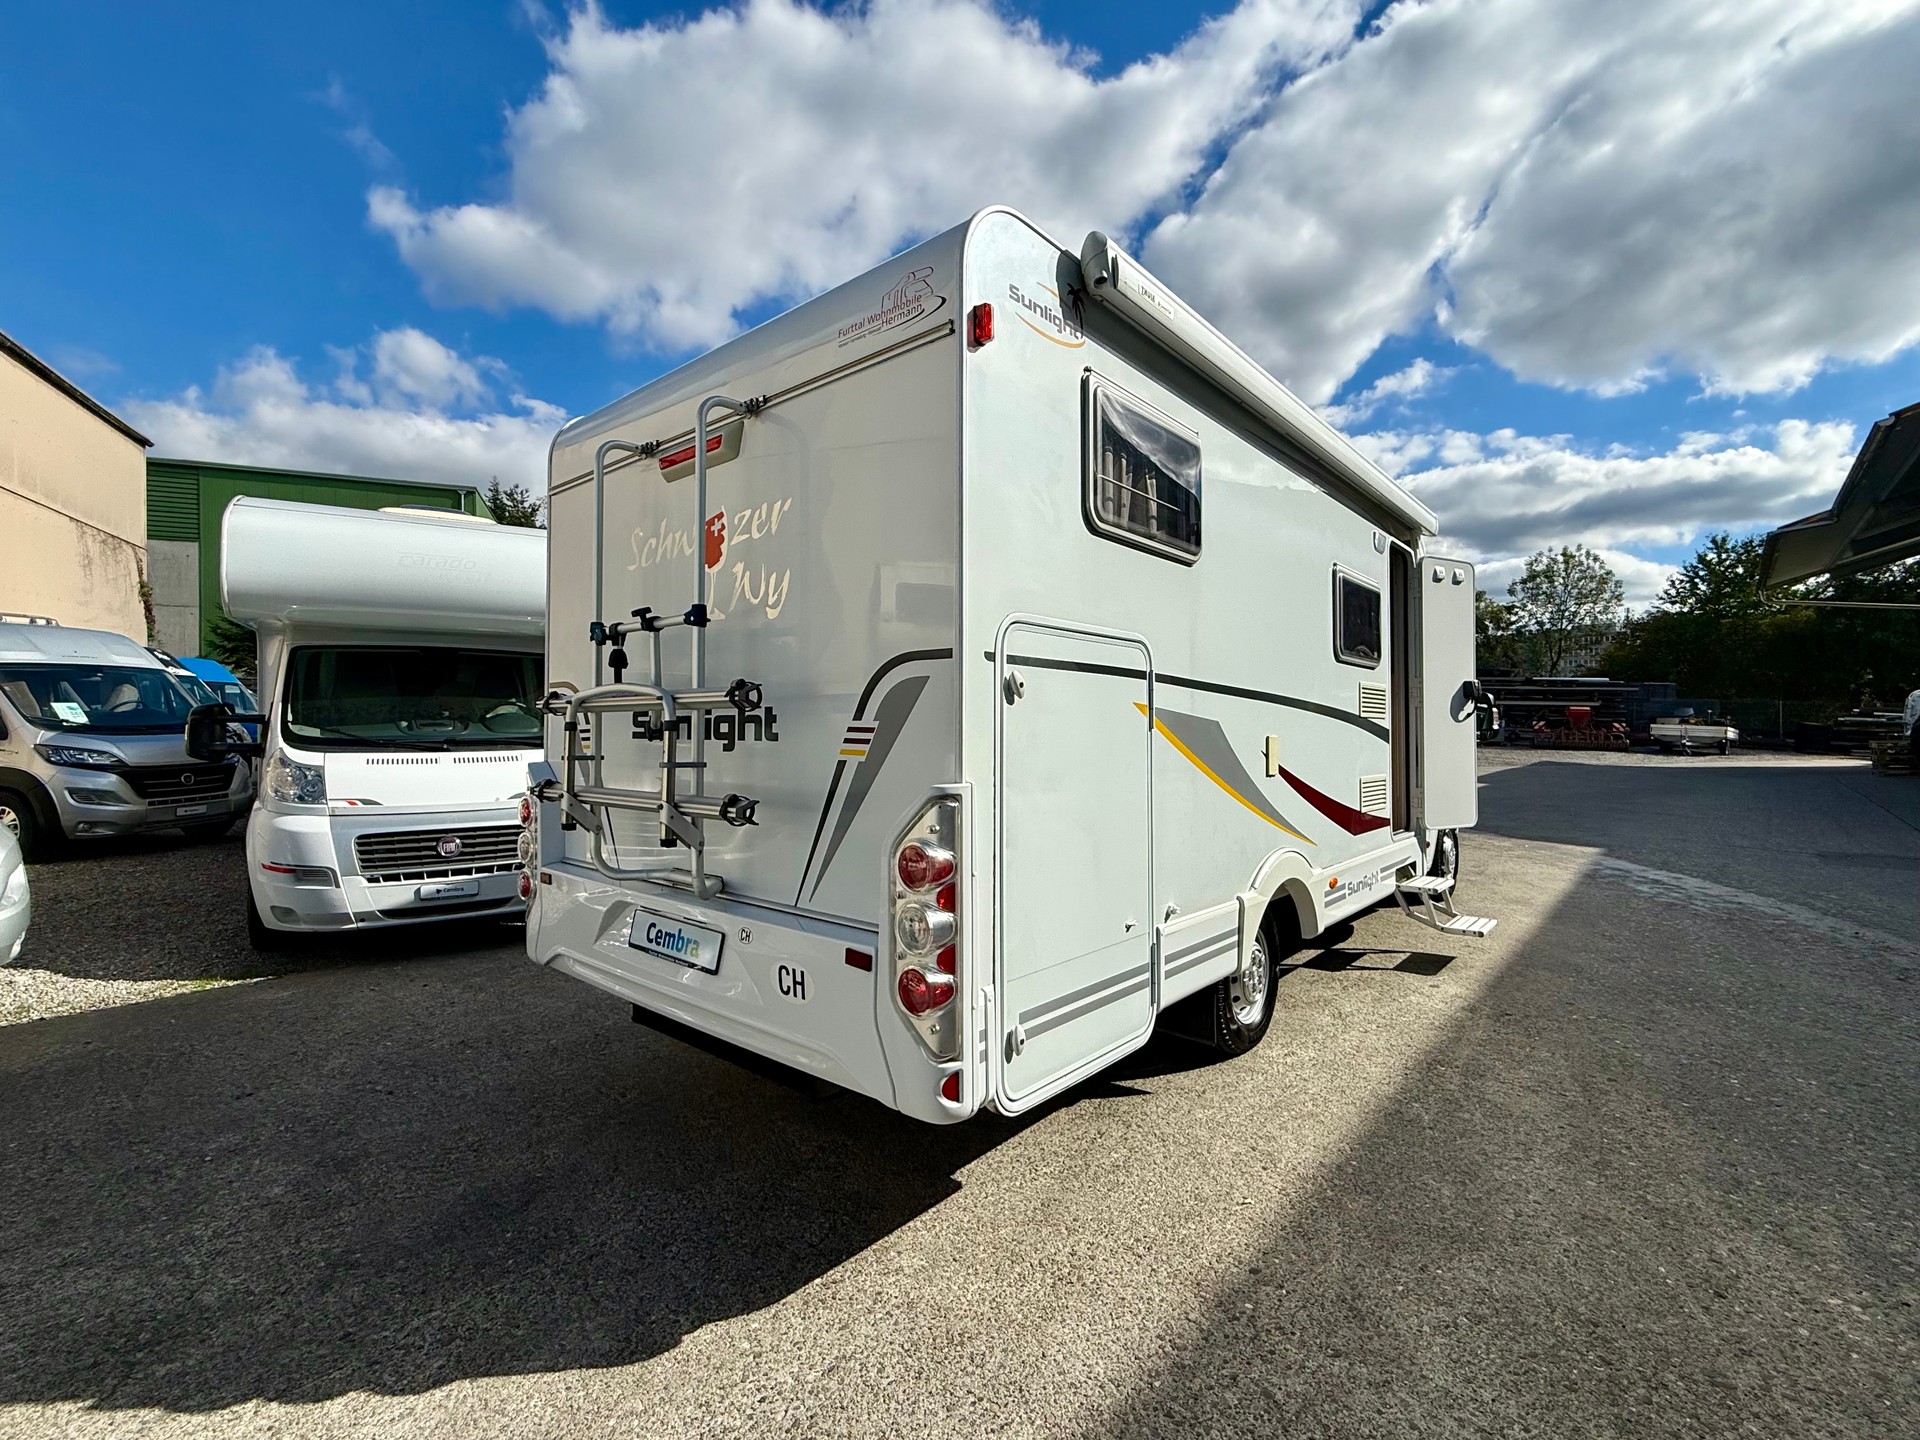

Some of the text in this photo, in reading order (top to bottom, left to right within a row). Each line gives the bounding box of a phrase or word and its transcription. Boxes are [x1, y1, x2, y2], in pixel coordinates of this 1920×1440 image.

[837, 317, 866, 338] Furttal
[867, 294, 922, 325] Wohnmobile
[881, 303, 922, 327] Hermann
[632, 706, 779, 752] Snight
[1347, 870, 1379, 897] Sunlight
[646, 922, 699, 959] Cembra
[740, 928, 751, 943] CH
[778, 964, 806, 1001] CH
